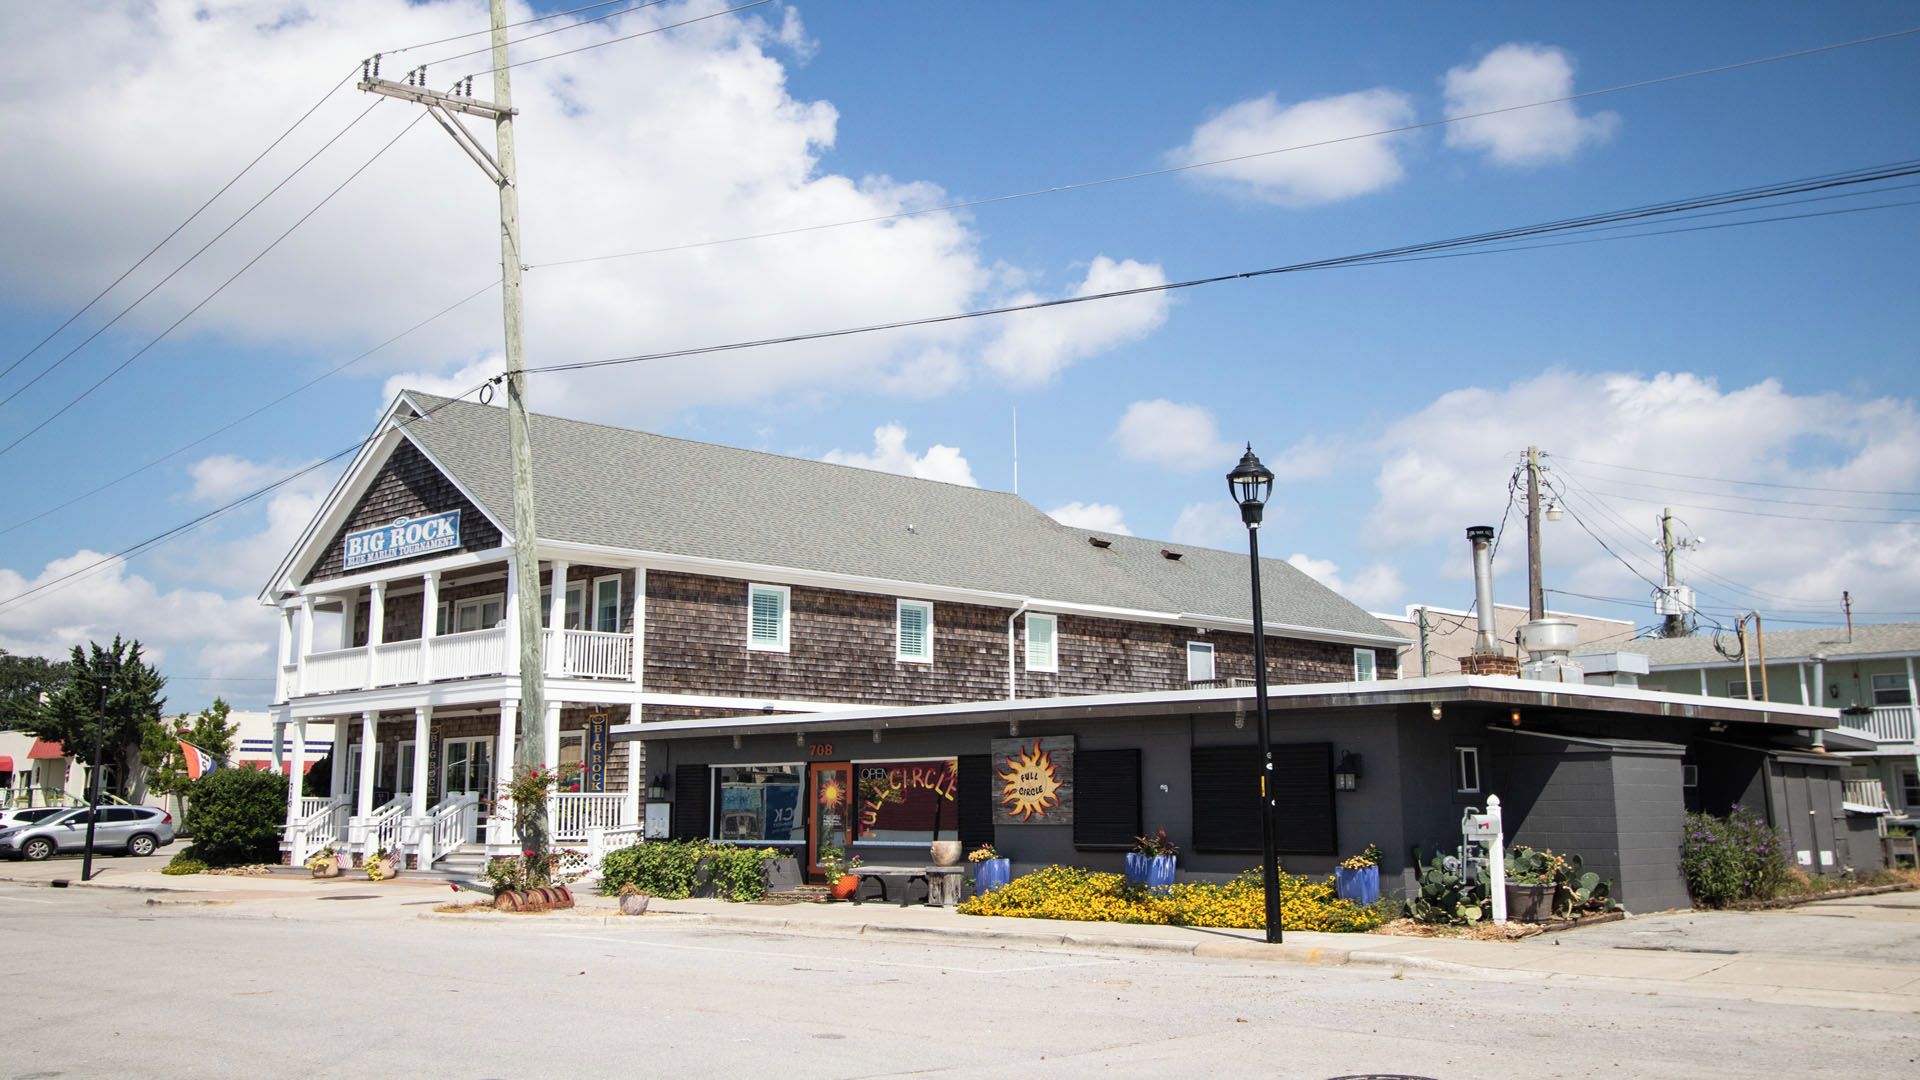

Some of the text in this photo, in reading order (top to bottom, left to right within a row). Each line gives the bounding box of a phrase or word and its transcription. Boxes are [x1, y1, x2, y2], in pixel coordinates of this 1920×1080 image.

[348, 516, 455, 557] BIG ROCK
[367, 547, 397, 562] MARLIN
[399, 536, 454, 554] TOURNAMENT
[592, 725, 602, 791] BIG ROCK
[809, 744, 833, 756] 708
[861, 768, 887, 780] OPEN
[1021, 772, 1038, 782] FULL
[889, 767, 958, 801] CIRCLE
[1019, 785, 1043, 796] CIRCLE
